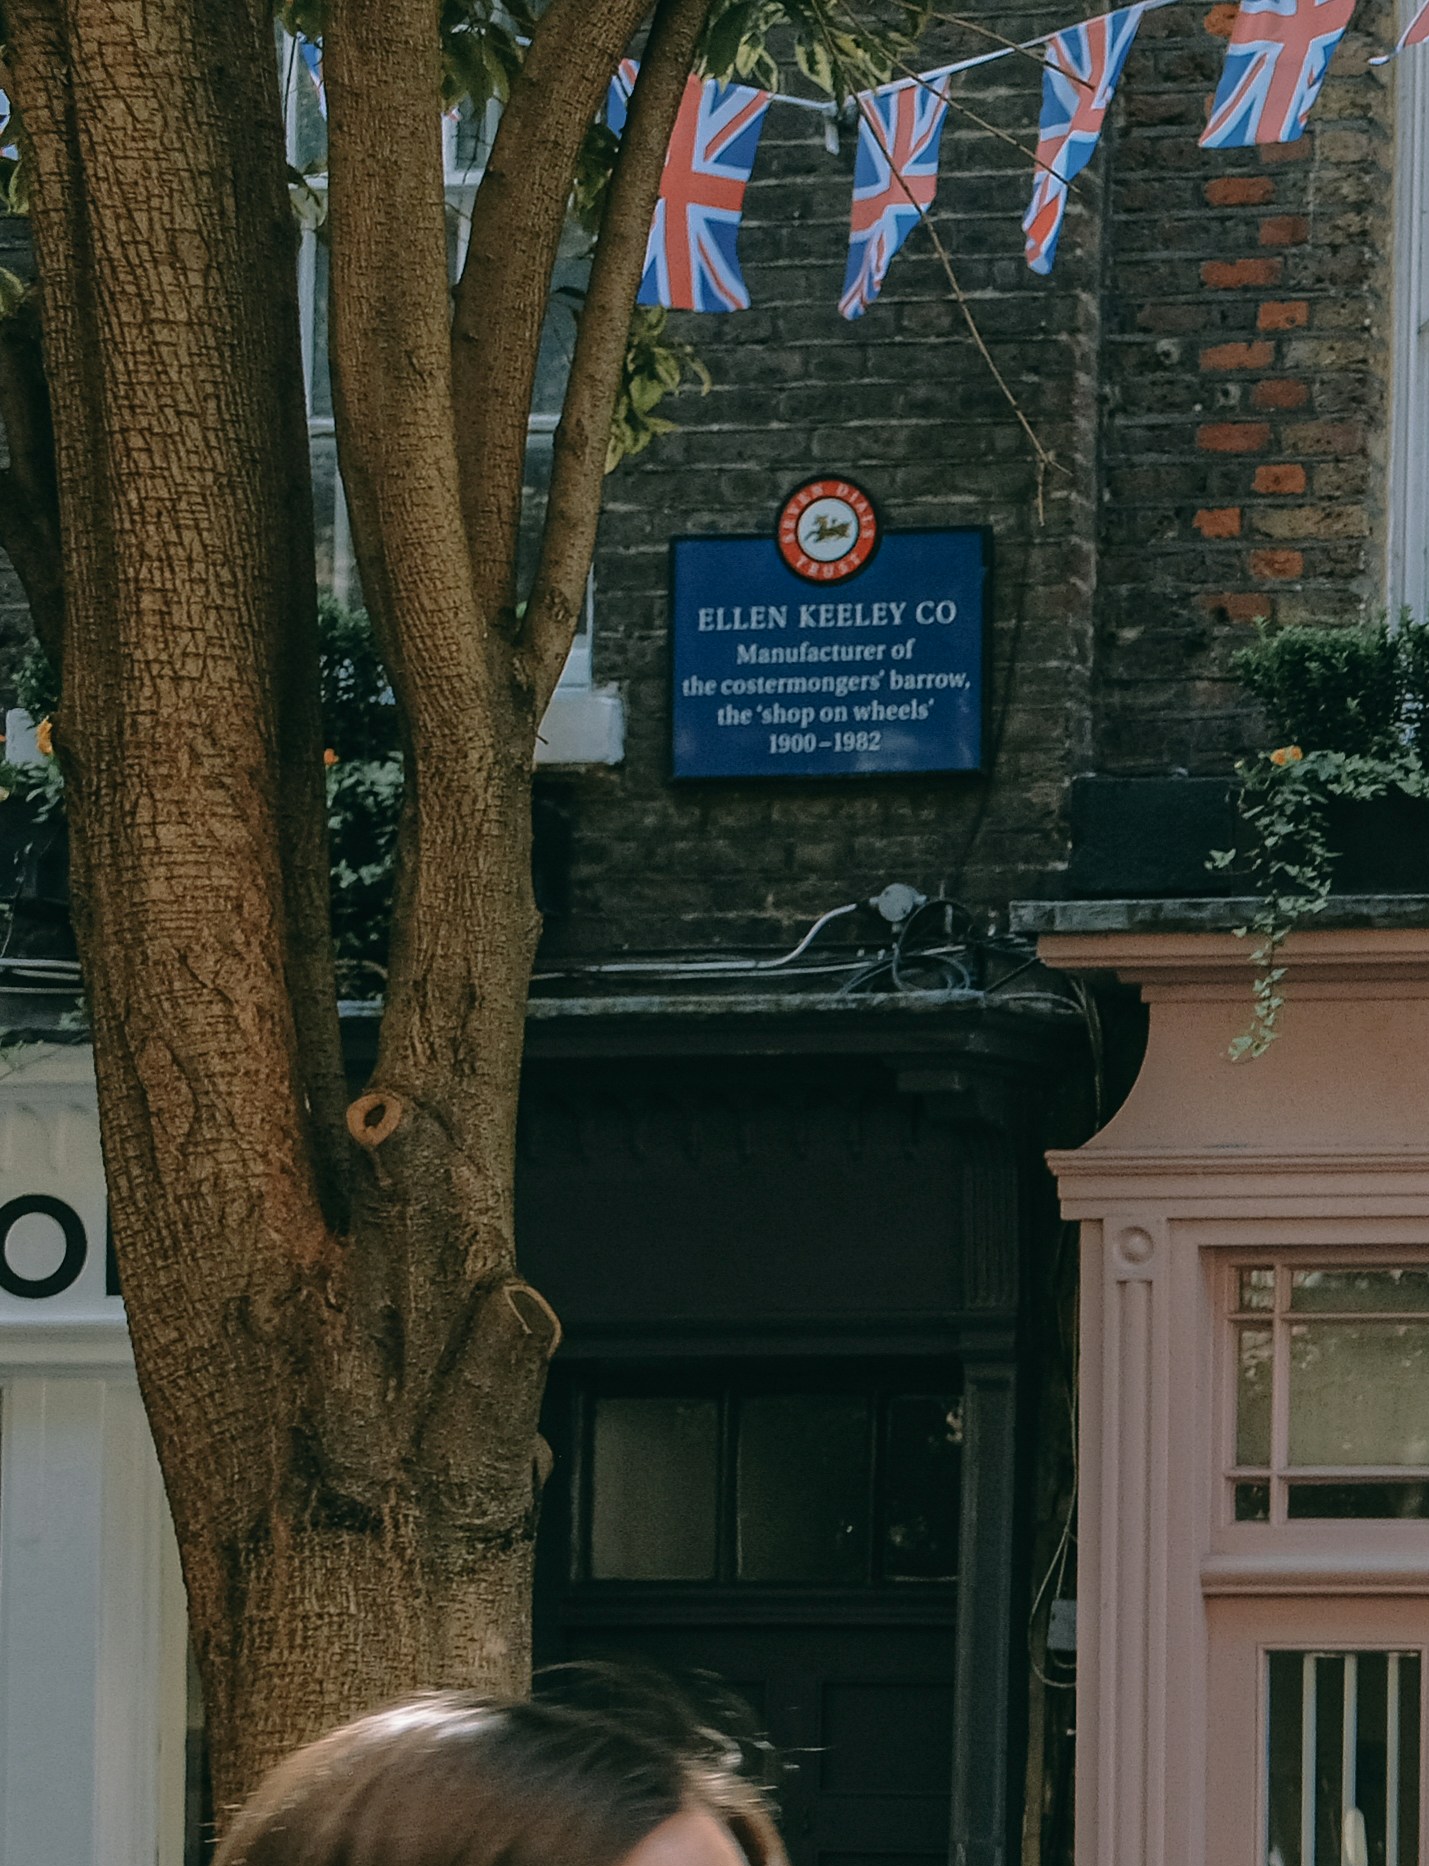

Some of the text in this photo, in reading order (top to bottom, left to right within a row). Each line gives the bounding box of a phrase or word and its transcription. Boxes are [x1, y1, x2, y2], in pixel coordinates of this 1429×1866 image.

[698, 600, 957, 632] ELLEN KEELEY CO
[736, 638, 916, 665] Manufacturer of
[682, 669, 971, 697] the costermongers’ barrow,
[717, 699, 935, 728] the ‘shop on wheels’
